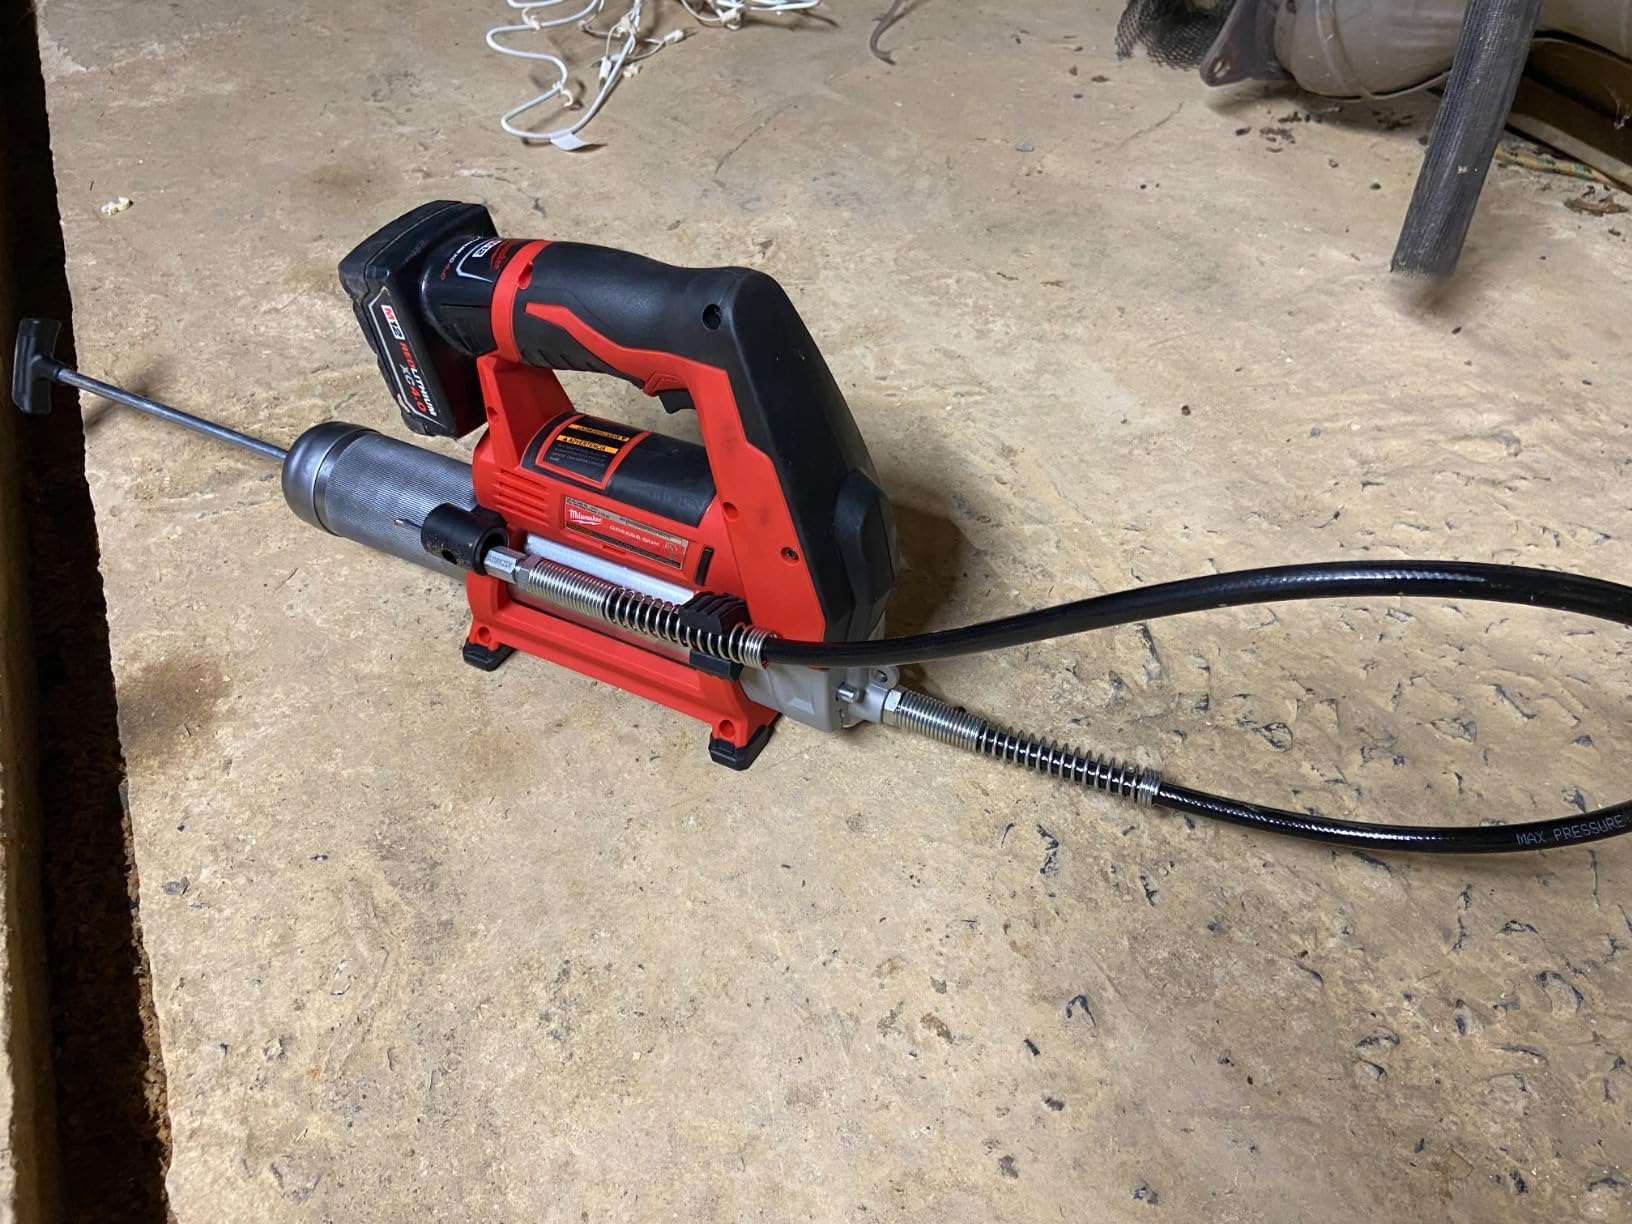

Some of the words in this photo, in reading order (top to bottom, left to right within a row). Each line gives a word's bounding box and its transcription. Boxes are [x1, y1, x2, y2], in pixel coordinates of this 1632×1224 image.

[383, 307, 403, 339] M12
[400, 341, 437, 416] REDLITHIUM
[570, 437, 605, 450] ADVERTENCIA
[568, 509, 603, 524] Milwaukee
[609, 525, 641, 541] GREASE
[642, 537, 660, 547] GUN
[1515, 830, 1546, 846] MAX
[1552, 814, 1626, 841] PRESSURE
